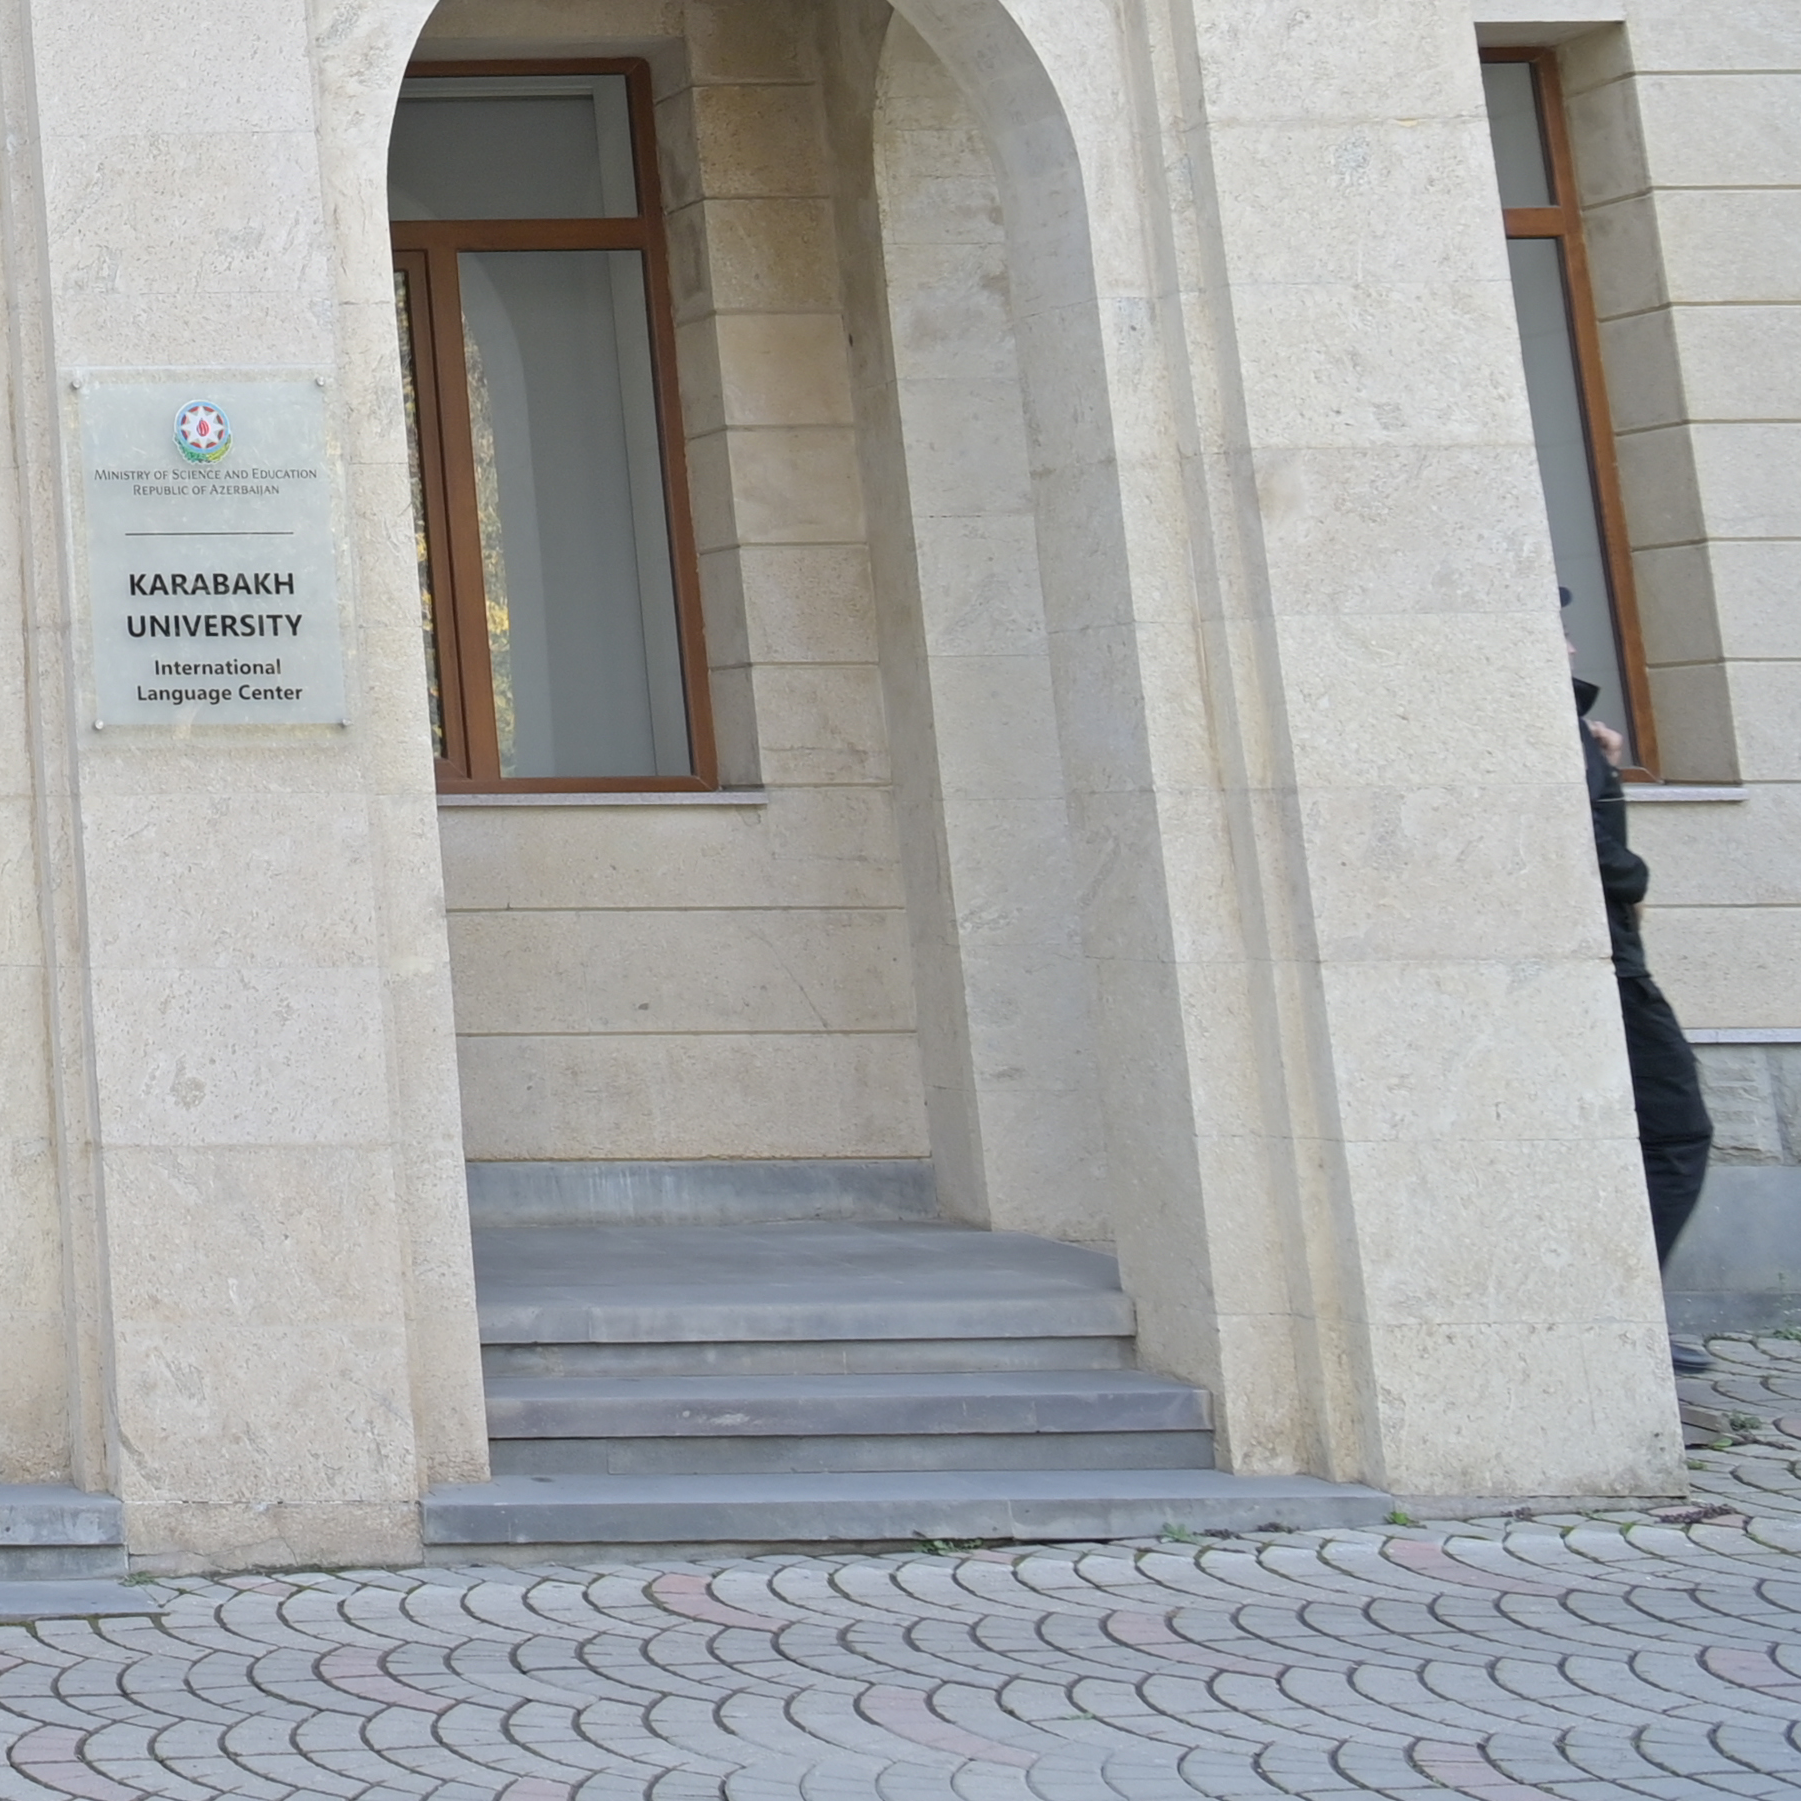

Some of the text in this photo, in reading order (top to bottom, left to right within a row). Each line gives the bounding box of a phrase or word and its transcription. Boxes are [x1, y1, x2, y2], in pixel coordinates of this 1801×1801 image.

[94, 468, 317, 481] MINISTRY OF SCIENCE AND EDUCATION
[133, 484, 279, 496] REPUBLIC OF AZERBAIJAN
[129, 573, 295, 596] KARABAKH
[127, 614, 303, 638] UNIVERSITY
[154, 658, 283, 676] International
[137, 684, 303, 705] Language Center
